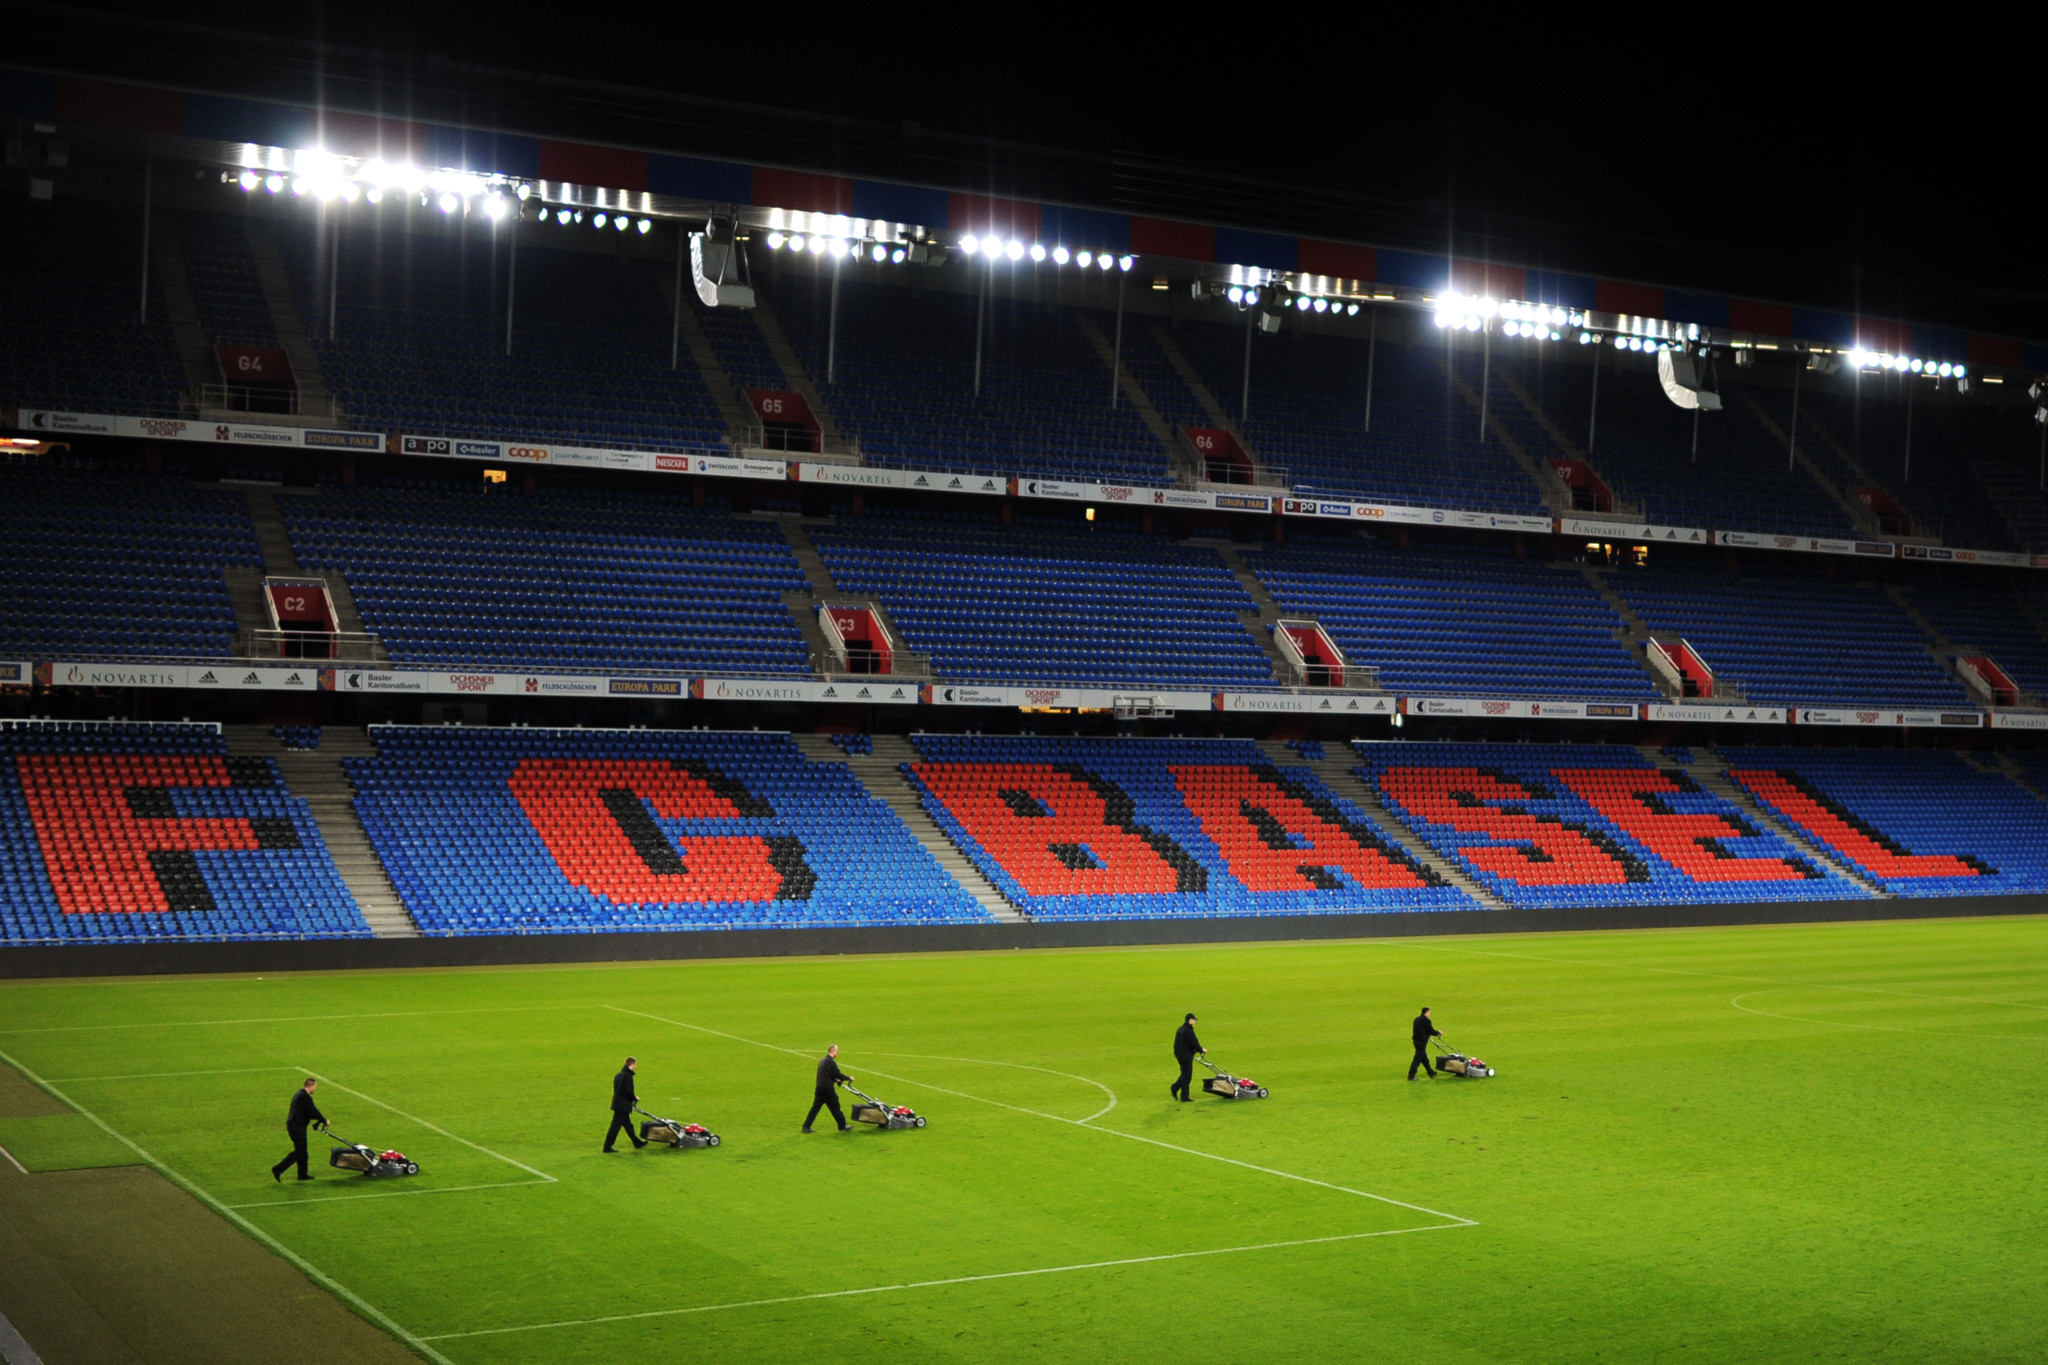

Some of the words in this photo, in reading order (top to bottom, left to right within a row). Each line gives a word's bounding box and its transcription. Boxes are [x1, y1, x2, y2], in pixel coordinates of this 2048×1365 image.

[238, 355, 262, 372] G4
[762, 398, 782, 413] G5
[140, 419, 186, 430] OCHSNER
[147, 428, 179, 437] SPORT
[307, 434, 346, 445] EUROPA
[349, 436, 375, 446] PARK
[1196, 435, 1213, 449] G6
[508, 447, 548, 461] coop
[832, 472, 892, 485] NOVARTIS
[1357, 507, 1384, 519] coop
[1584, 527, 1626, 537] NOVARTIS
[284, 597, 305, 611] C2
[838, 618, 855, 631] C3
[91, 673, 174, 685] NOVARTIS
[450, 675, 494, 684] OCHSNER
[368, 681, 421, 690] Kantonalbank
[456, 683, 487, 691] SPORT
[611, 682, 649, 692] EUROPA
[652, 683, 677, 693] PARK
[735, 688, 801, 699] NOVARTIS
[959, 688, 979, 696] Basler
[1025, 690, 1060, 698] OCHSNER
[959, 695, 1002, 703] Kantonalbank
[1249, 700, 1302, 710] NOVARTIS
[1668, 710, 1711, 720] NOVARTIS
